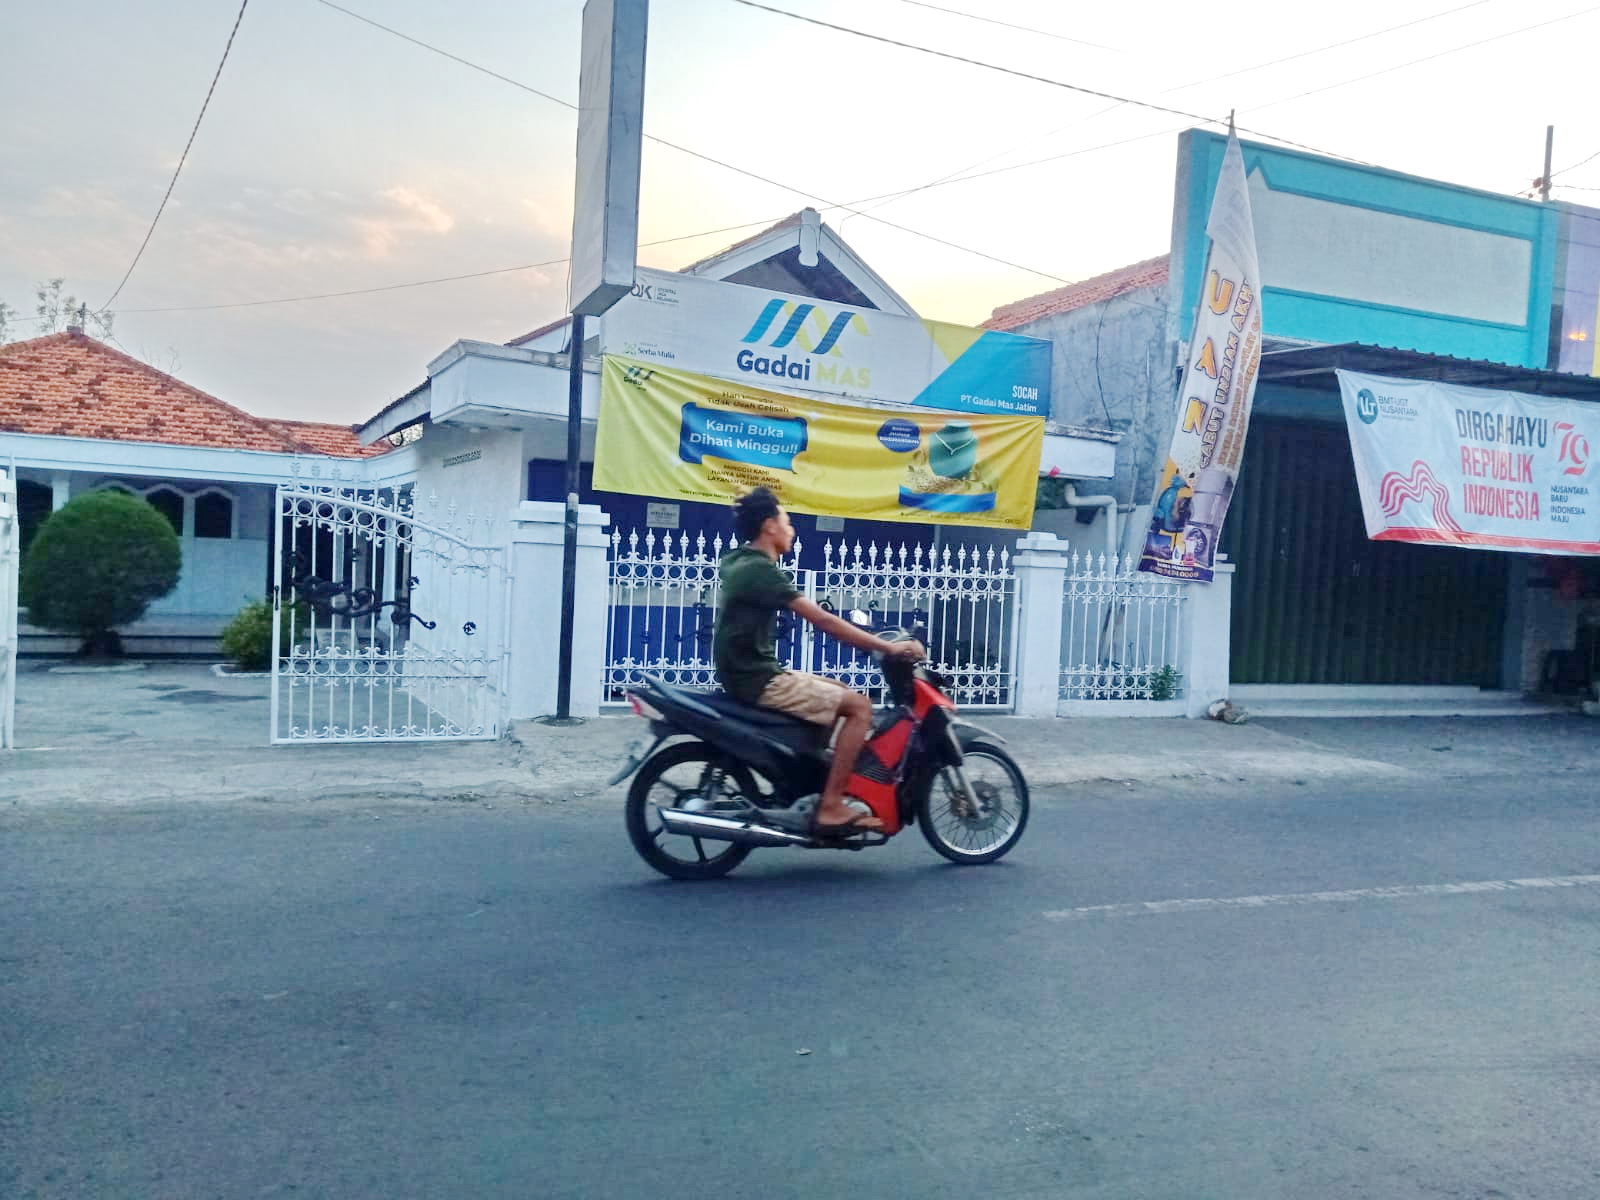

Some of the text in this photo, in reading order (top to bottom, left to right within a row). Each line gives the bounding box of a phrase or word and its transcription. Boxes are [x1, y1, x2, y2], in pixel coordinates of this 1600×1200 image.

[737, 350, 872, 390] Gadai MAS
[1214, 331, 1240, 405] UNDIAN
[1012, 385, 1038, 401] SOCAH
[960, 394, 1037, 413] PT Gadai Mas Jatim
[1380, 405, 1419, 417] NUSANTARA
[706, 419, 784, 438] Kami Buka
[1456, 408, 1548, 448] DIRGAHAYU
[690, 433, 799, 455] Dihari Minggu!!
[1460, 445, 1535, 484] REPUBLIK
[1550, 485, 1590, 495] NUSANTARA
[1550, 494, 1569, 503] BARU
[1463, 483, 1541, 521] INDONESIA
[1550, 505, 1586, 515] INDONESIA
[1550, 514, 1570, 523] MAJU
